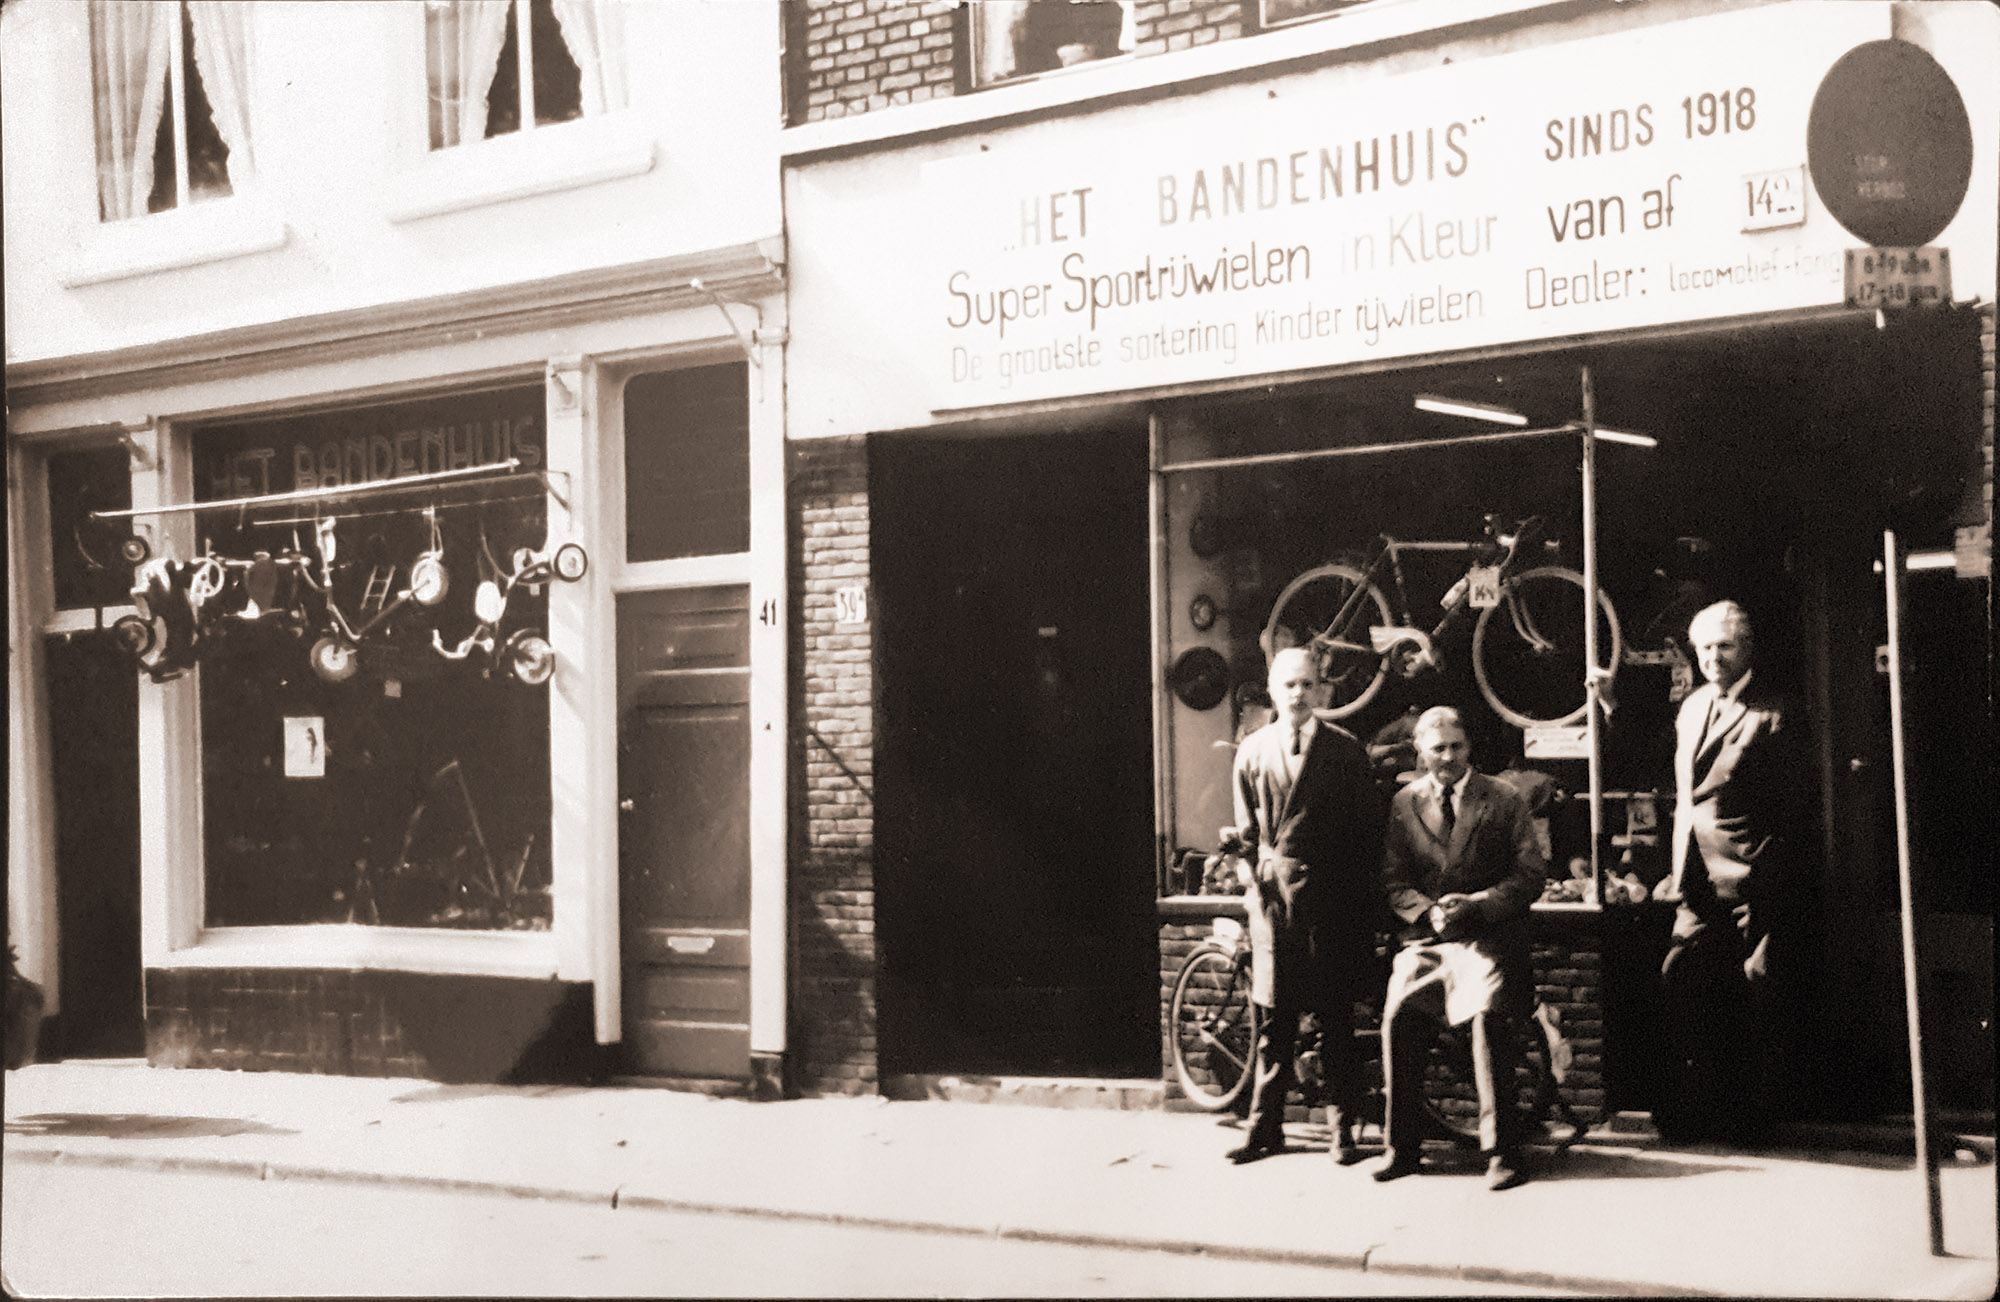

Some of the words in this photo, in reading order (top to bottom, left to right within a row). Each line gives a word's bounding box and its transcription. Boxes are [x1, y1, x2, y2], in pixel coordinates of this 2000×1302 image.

[1545, 103, 1655, 162] SINDS
[1682, 86, 1757, 140] 1918
[947, 270, 1053, 339] Super
[1062, 241, 1310, 331] Sportrijwielen
[1340, 231, 1376, 273] in
[1388, 211, 1498, 266] Kleur
[1546, 193, 1626, 243] van
[1642, 173, 1682, 230] af
[952, 346, 984, 384] De
[999, 335, 1102, 390] grootste
[1119, 319, 1238, 365] sortering
[1255, 302, 1343, 346] Kinder
[759, 598, 777, 627] 41
